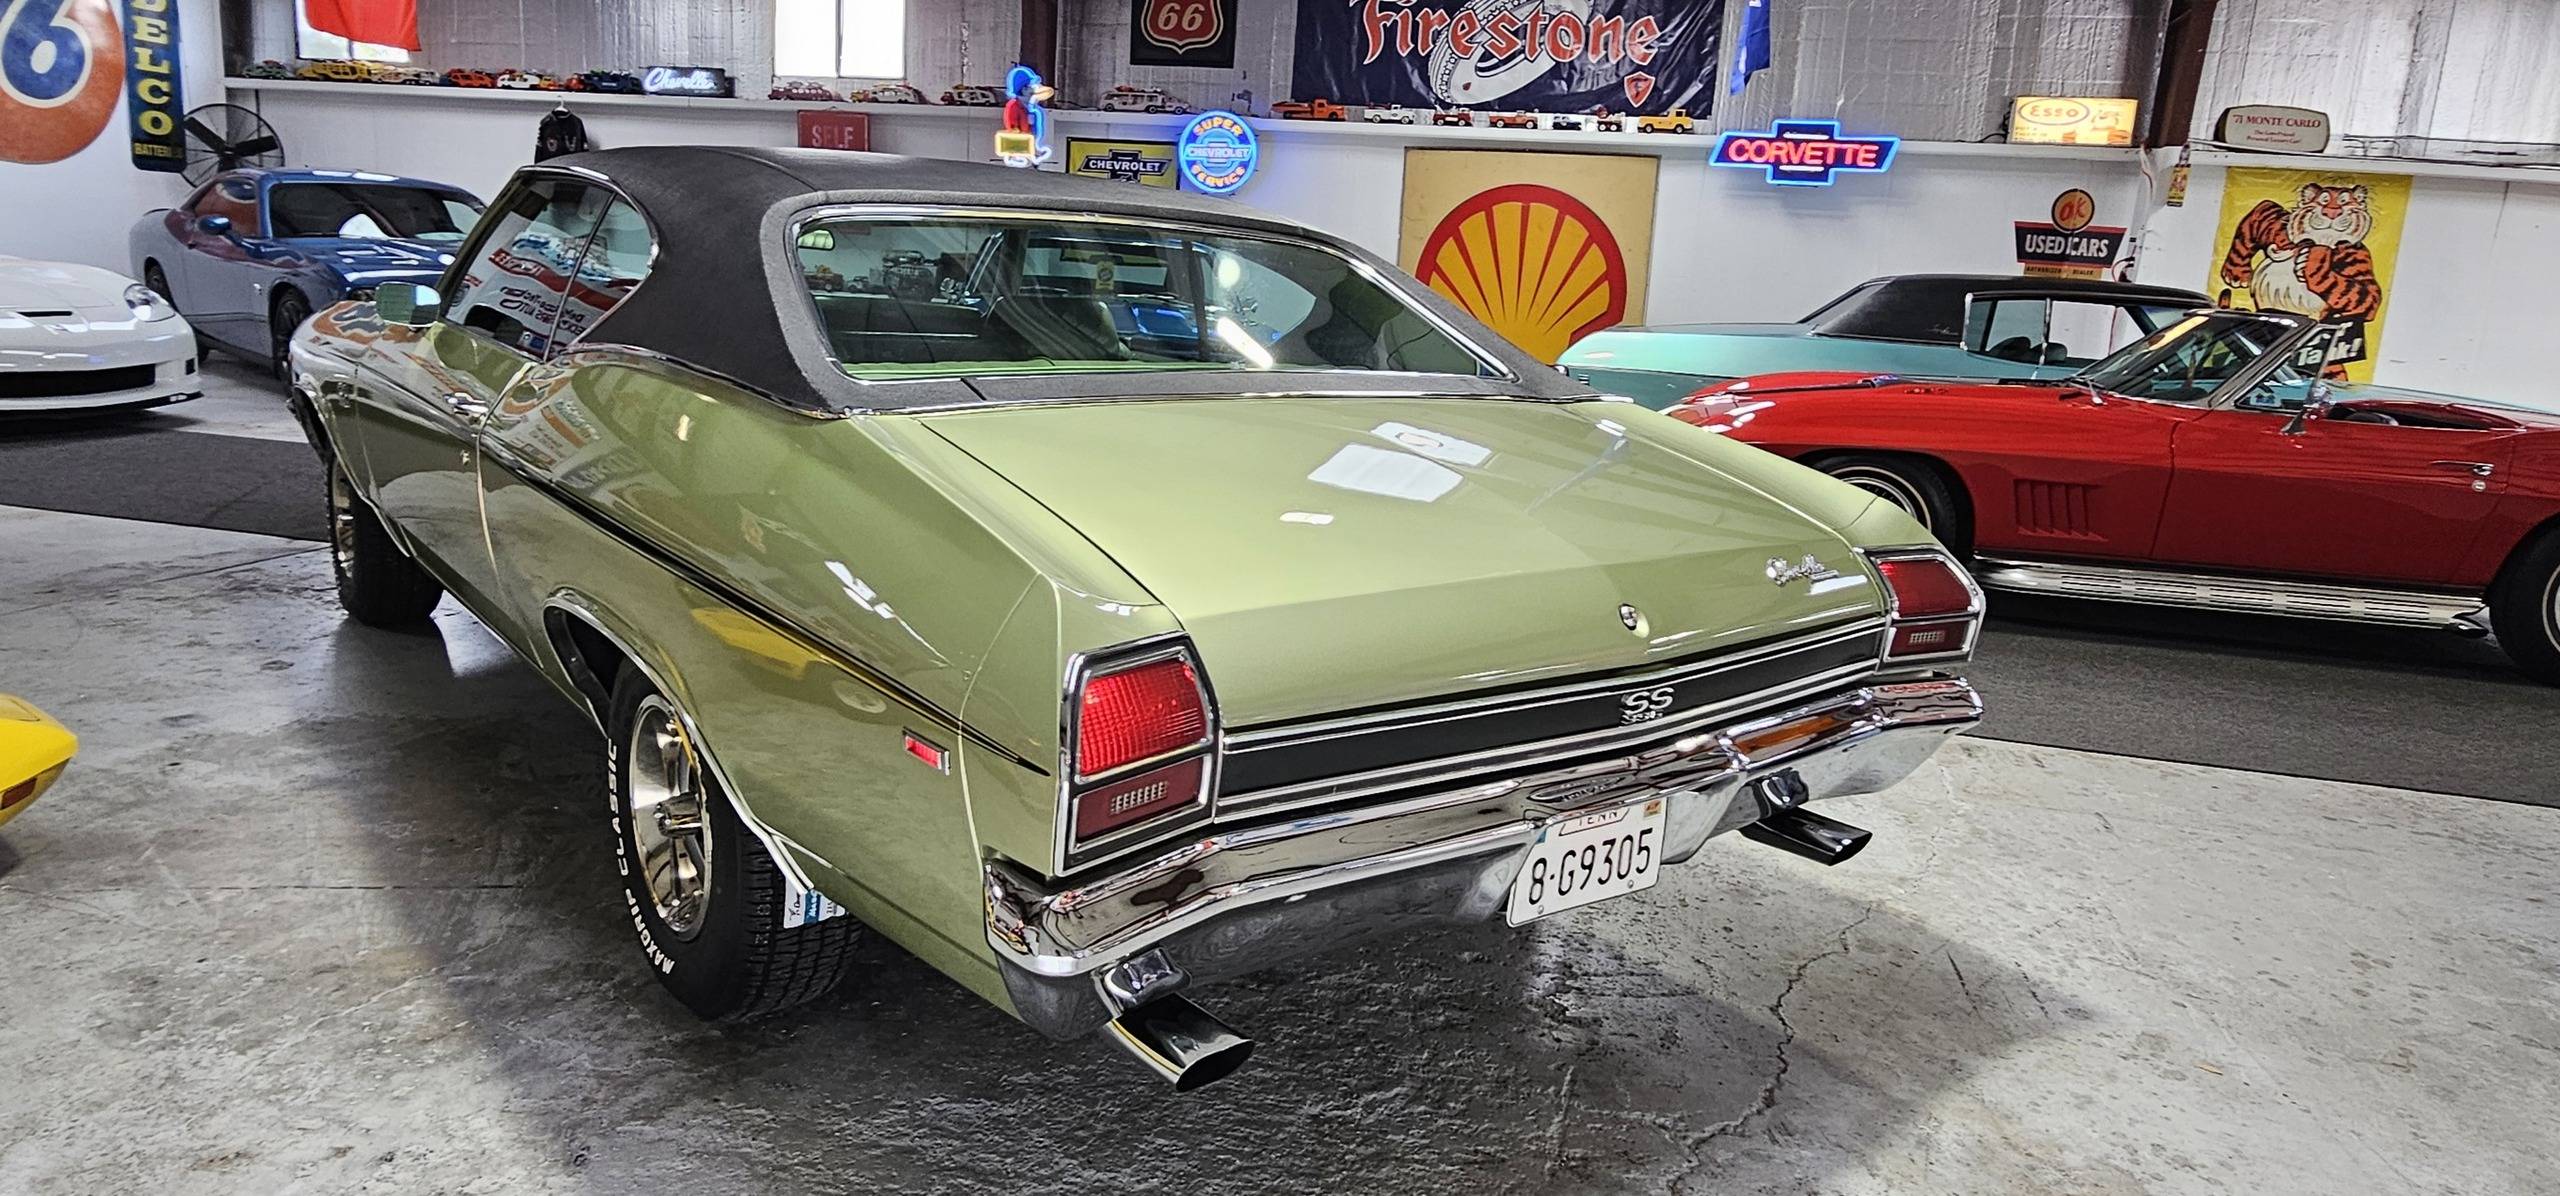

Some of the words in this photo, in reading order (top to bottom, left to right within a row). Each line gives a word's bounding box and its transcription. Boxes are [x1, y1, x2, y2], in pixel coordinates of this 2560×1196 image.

[1158, 2, 1205, 31] 66
[1363, 0, 1660, 65] Firestone
[1193, 116, 1243, 136] SUPER
[2246, 115, 2283, 126] MONTE
[2286, 118, 2321, 128] CARLO
[1089, 159, 1160, 172] CHEVROLET
[1188, 147, 1250, 159] CHEVROLET
[1728, 138, 1879, 167] CORVETTE
[2025, 234, 2065, 255] USED
[2066, 236, 2109, 258] CARS
[1622, 687, 1675, 715] SS
[608, 738, 629, 876] CLASSIC
[625, 888, 675, 975] MAXGRIP
